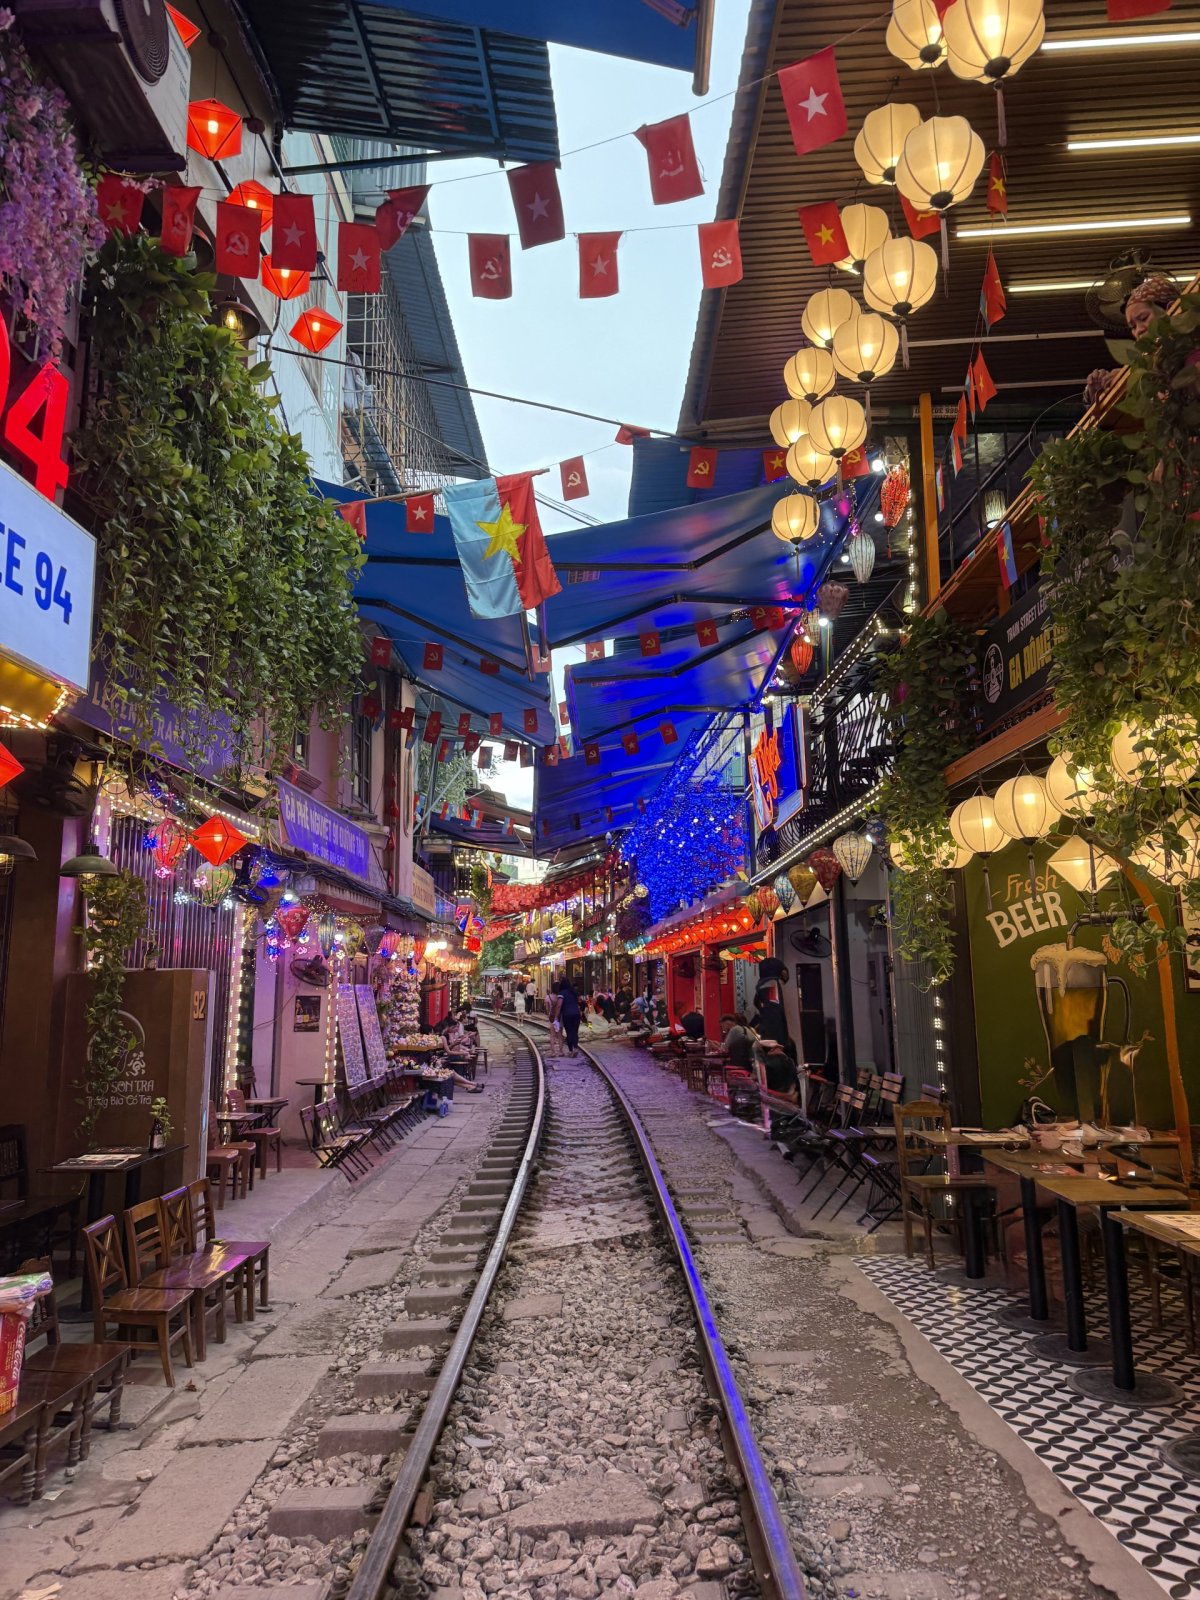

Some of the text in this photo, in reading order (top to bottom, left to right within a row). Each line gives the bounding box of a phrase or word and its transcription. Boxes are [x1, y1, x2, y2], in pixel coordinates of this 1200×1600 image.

[35, 551, 72, 625] 94
[1006, 620, 1020, 643] TRAIN
[1020, 604, 1037, 631] STREET
[1008, 653, 1022, 690] GA
[284, 792, 296, 823] CÀ
[1004, 864, 1059, 902] Fresh
[985, 891, 1068, 949] BEER
[193, 990, 206, 1019] 92
